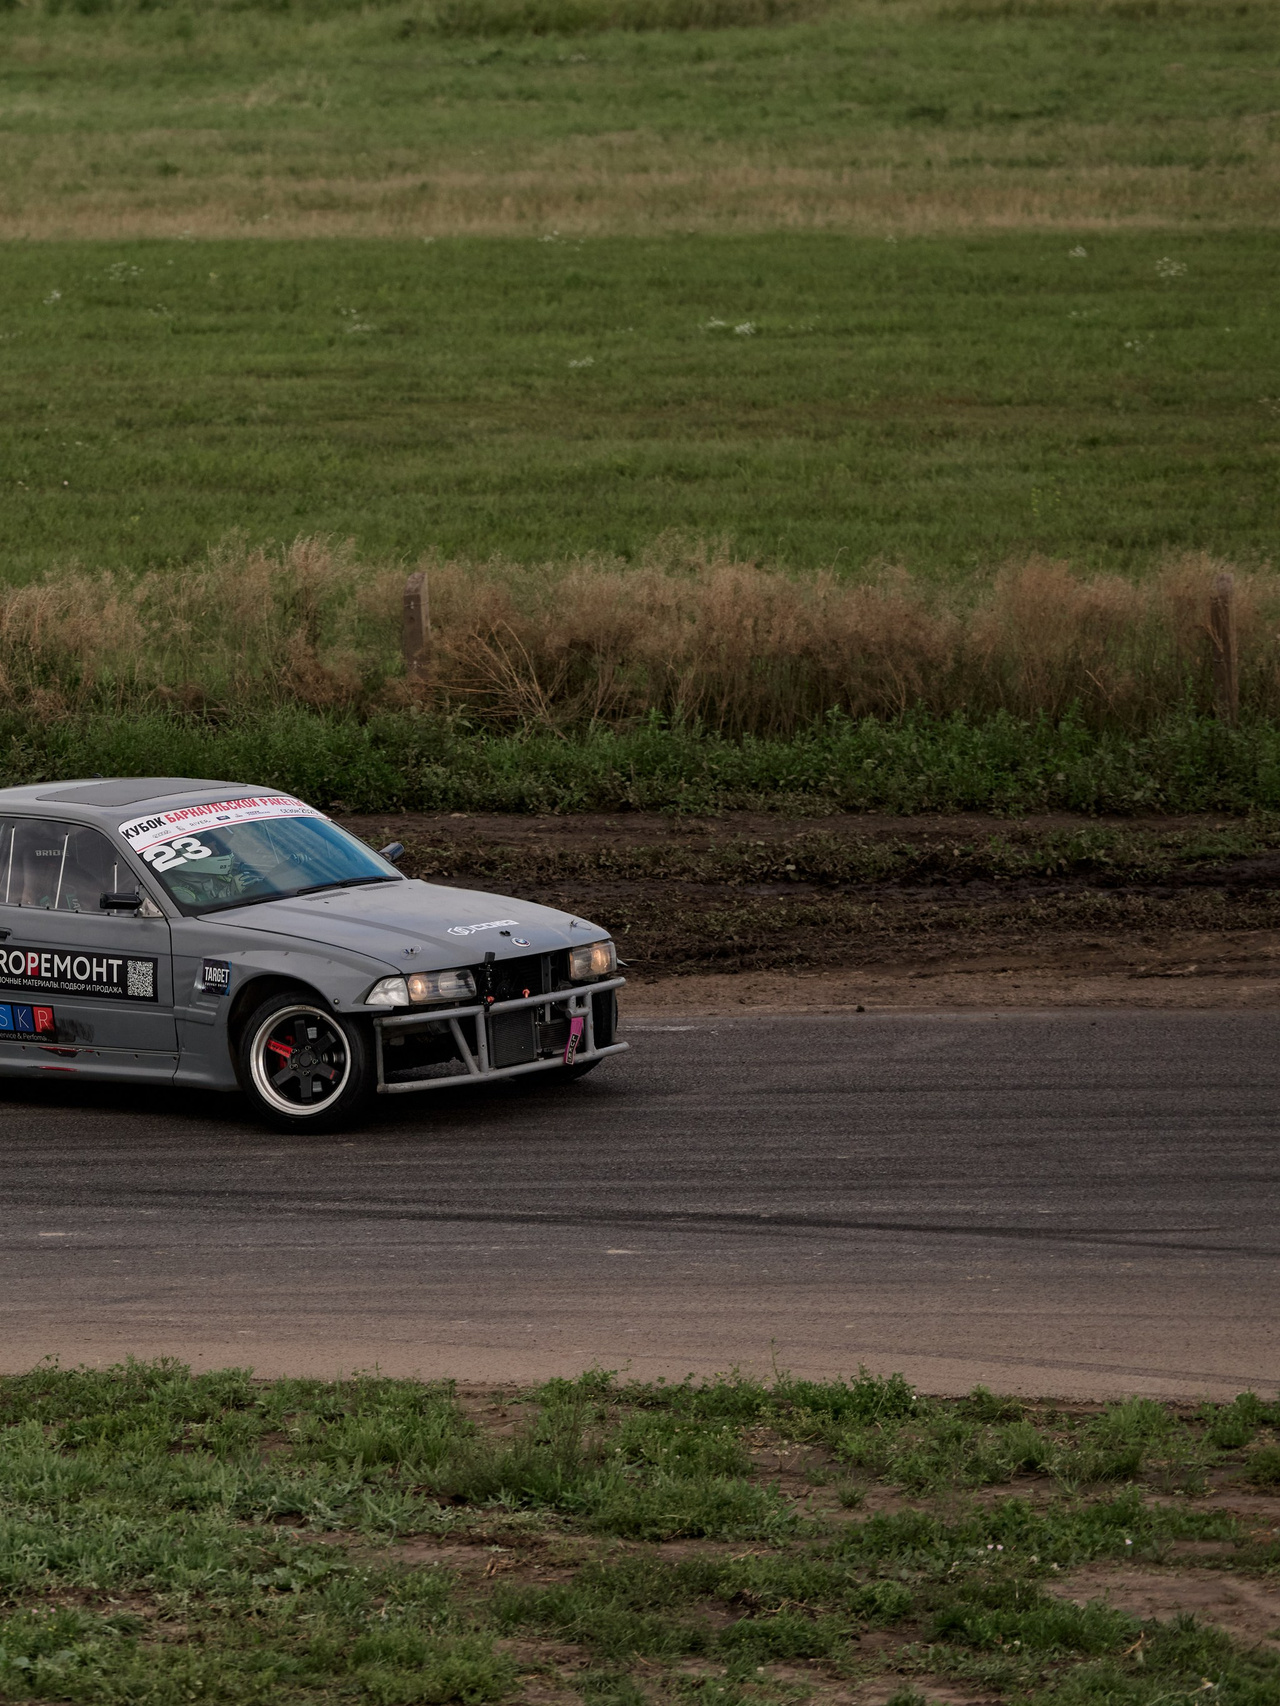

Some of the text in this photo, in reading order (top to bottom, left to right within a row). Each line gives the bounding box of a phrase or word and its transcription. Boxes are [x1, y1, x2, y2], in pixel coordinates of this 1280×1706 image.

[121, 817, 166, 839] КУБОК
[143, 837, 212, 873] 23
[204, 966, 230, 983] TARGET
[60, 981, 85, 992] ПОДБОР
[92, 984, 123, 994] ПРОДАЖА
